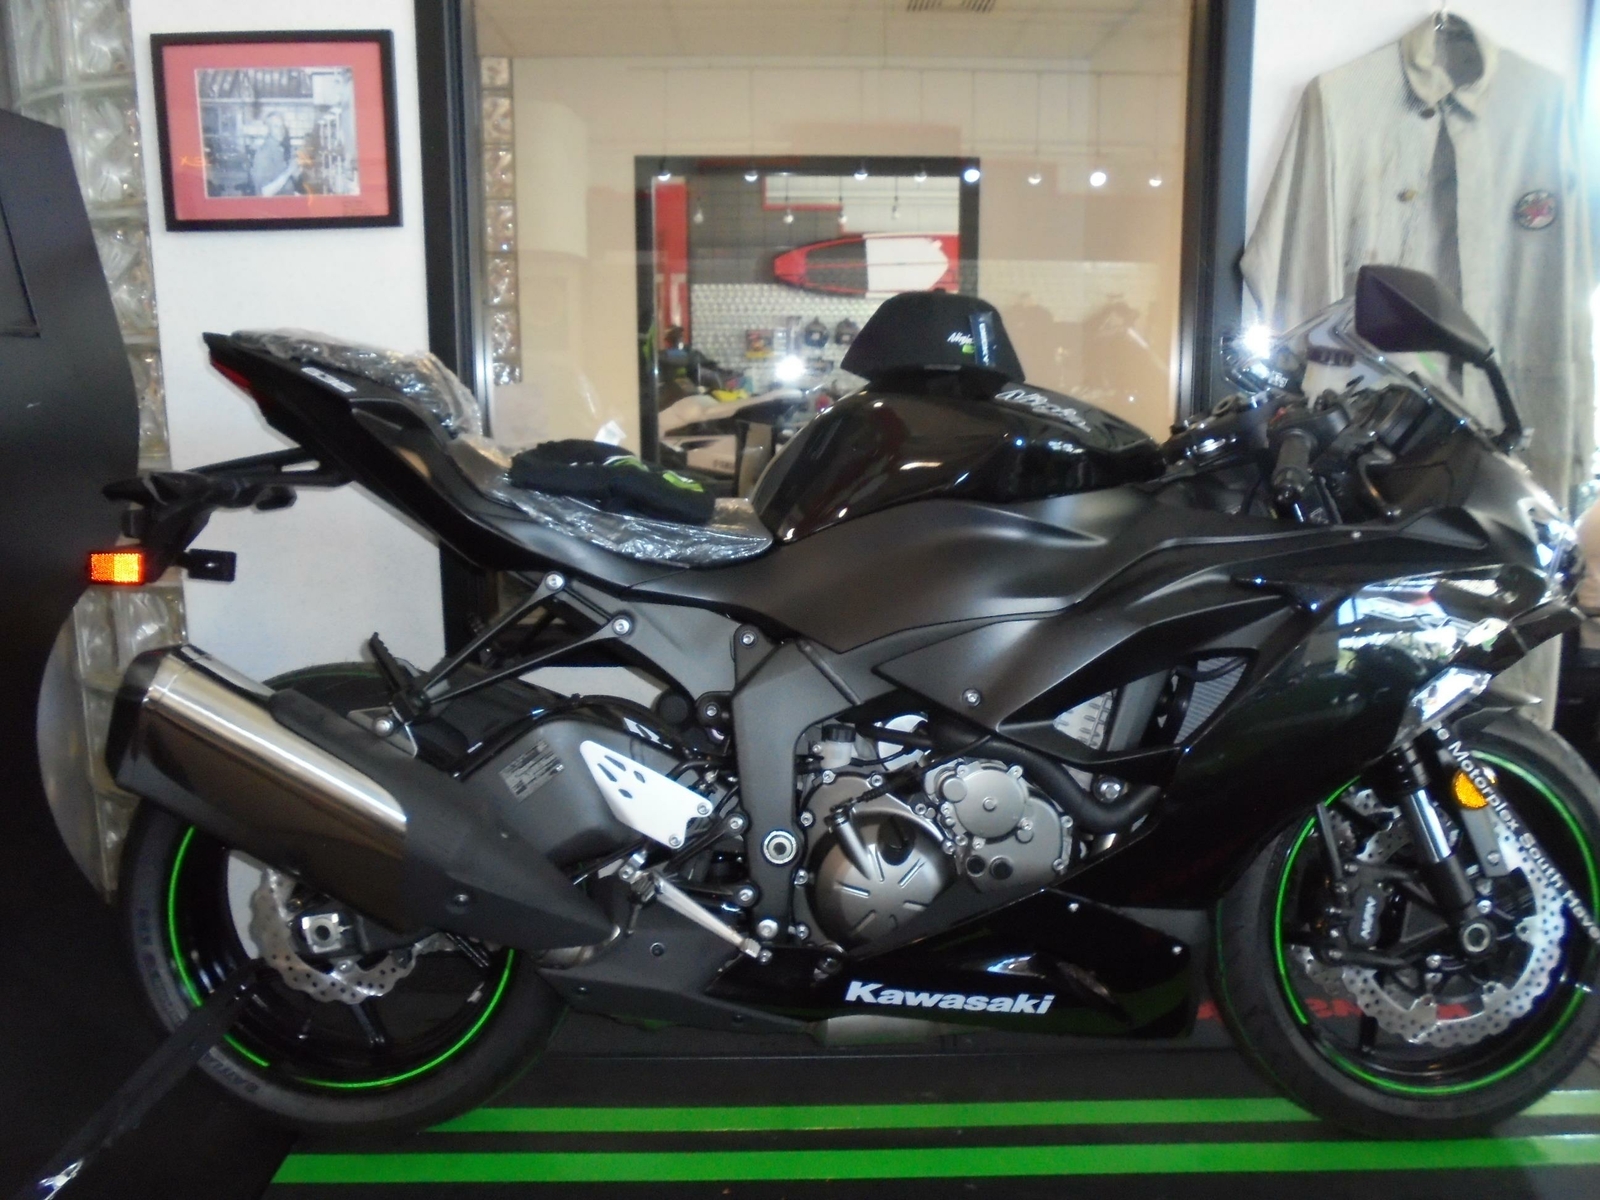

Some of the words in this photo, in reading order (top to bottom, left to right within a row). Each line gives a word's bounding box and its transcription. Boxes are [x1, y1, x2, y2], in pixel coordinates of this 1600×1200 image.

[1448, 741, 1518, 831] Motorplex
[1519, 832, 1564, 888] South
[1562, 889, 1600, 944] Have
[845, 980, 1055, 1014] Kawasaki
